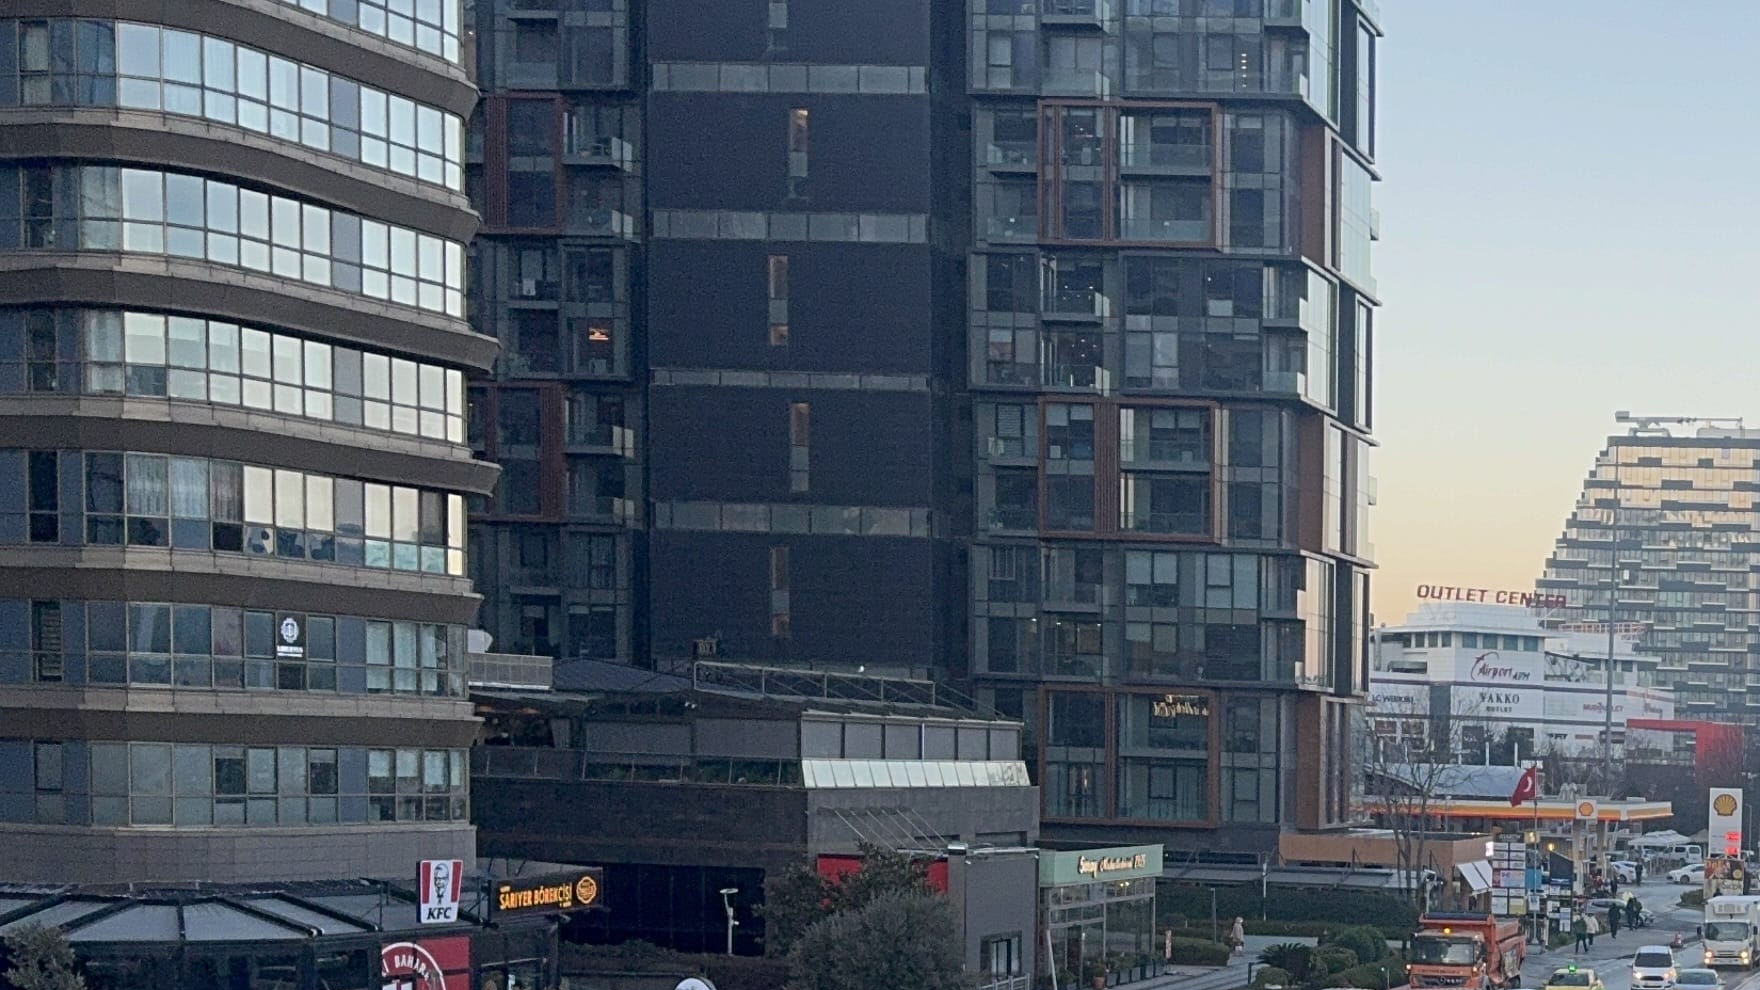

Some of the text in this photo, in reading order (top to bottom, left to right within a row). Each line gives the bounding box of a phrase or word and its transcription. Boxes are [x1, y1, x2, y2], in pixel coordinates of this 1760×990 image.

[1417, 584, 1567, 609] OUTLET CENTER
[1477, 662, 1513, 682] Airport
[1479, 692, 1520, 705] VAKKO
[500, 889, 533, 910] SARIYER
[426, 907, 452, 920] KFC
